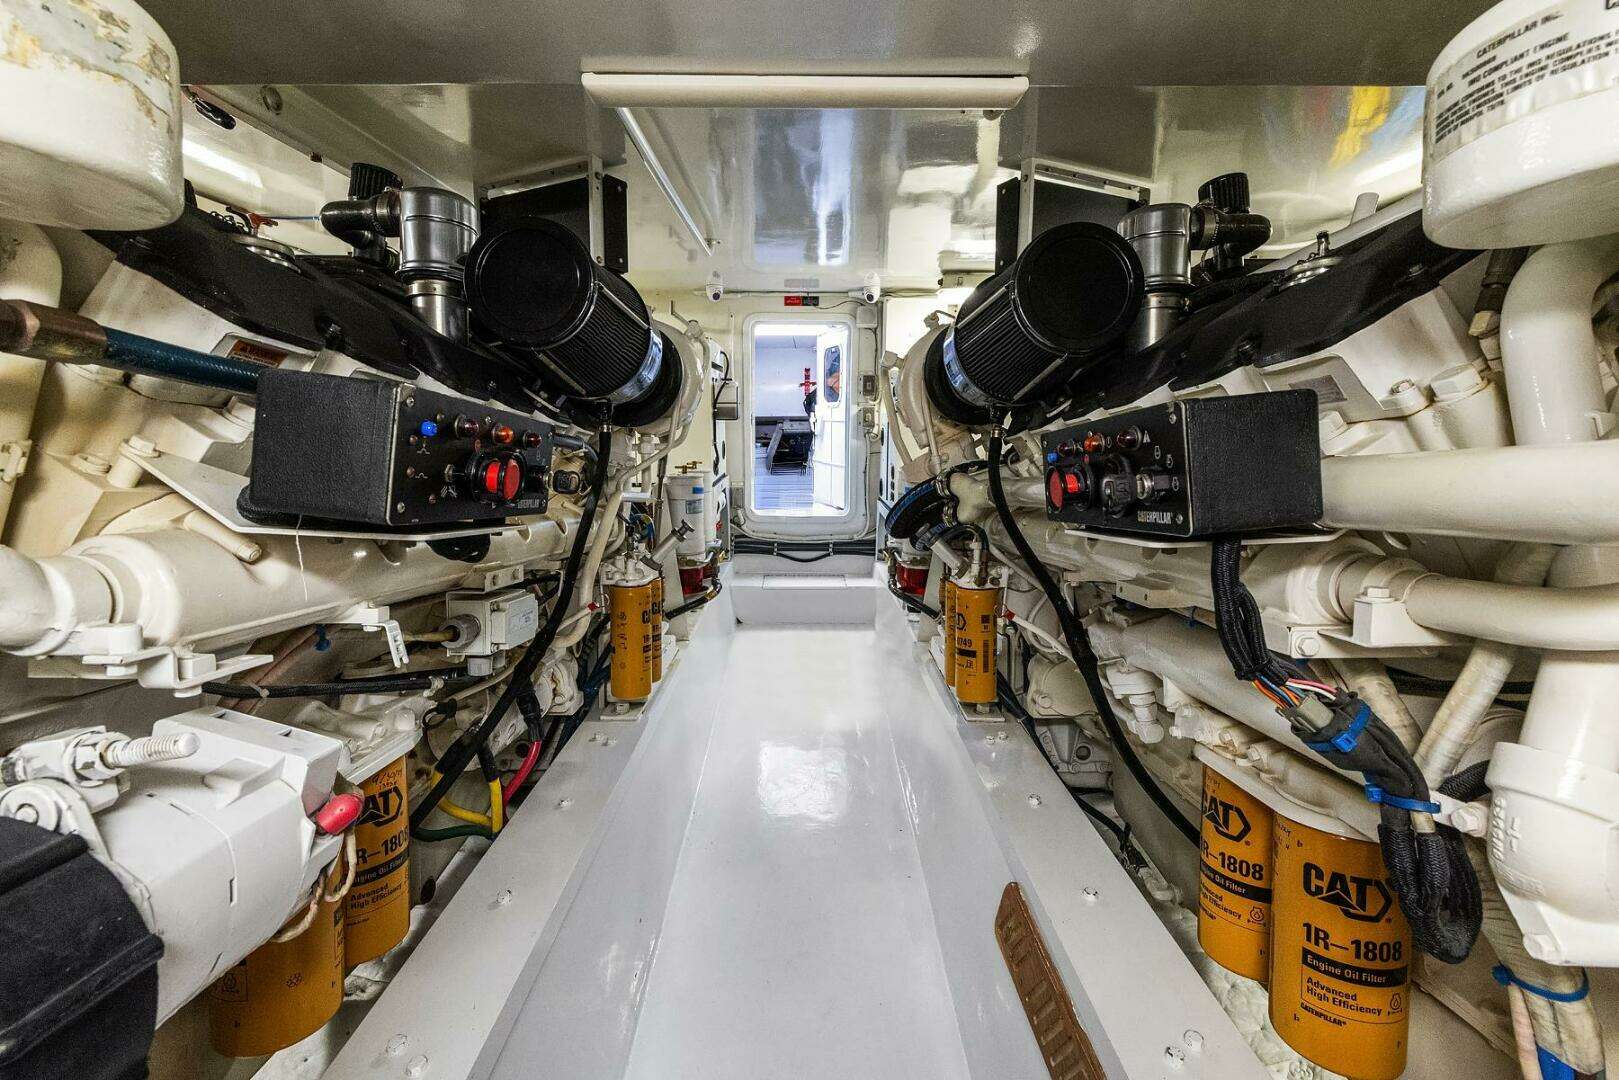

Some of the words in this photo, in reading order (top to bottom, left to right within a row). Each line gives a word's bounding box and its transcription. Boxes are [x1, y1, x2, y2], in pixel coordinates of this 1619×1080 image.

[1476, 21, 1538, 59] CATERPILLAR
[351, 883, 389, 902] Advanced
[1215, 873, 1226, 888] Oil
[1225, 881, 1246, 895] Filter
[1303, 862, 1368, 912] CAT
[1307, 954, 1341, 976] Engine
[1344, 969, 1359, 980] Oil
[1362, 973, 1386, 983] Filter
[1306, 976, 1357, 1002] Advanced
[1306, 985, 1330, 1003] High
[1332, 997, 1383, 1017] Efficiency
